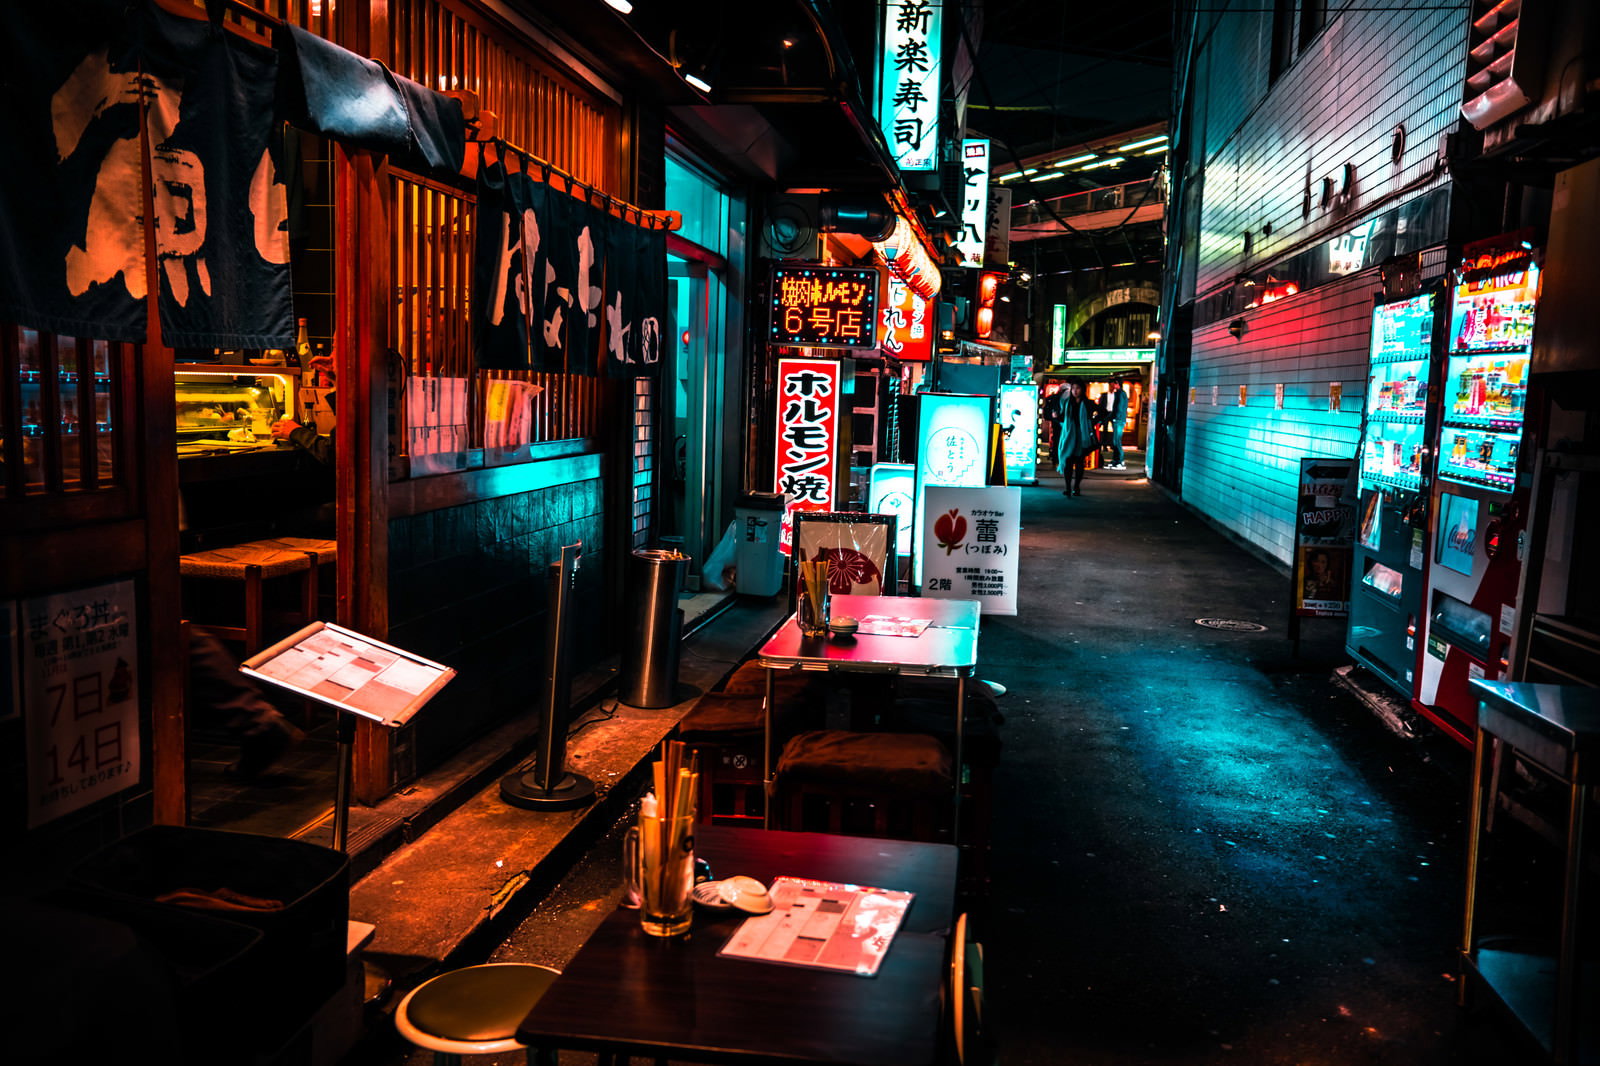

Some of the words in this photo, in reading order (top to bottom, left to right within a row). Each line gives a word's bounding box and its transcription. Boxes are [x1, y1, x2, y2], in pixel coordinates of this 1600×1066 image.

[893, 0, 933, 151] 新楽寿司
[781, 277, 866, 307] 焼肉ホルモン
[785, 307, 863, 338] 6号店
[782, 373, 830, 502] ホルモン焼
[976, 518, 999, 543] 蕾
[965, 542, 1007, 557] (つぼみ)
[929, 578, 952, 591] 2階
[46, 671, 102, 728] 7日
[46, 721, 121, 786] 14日
